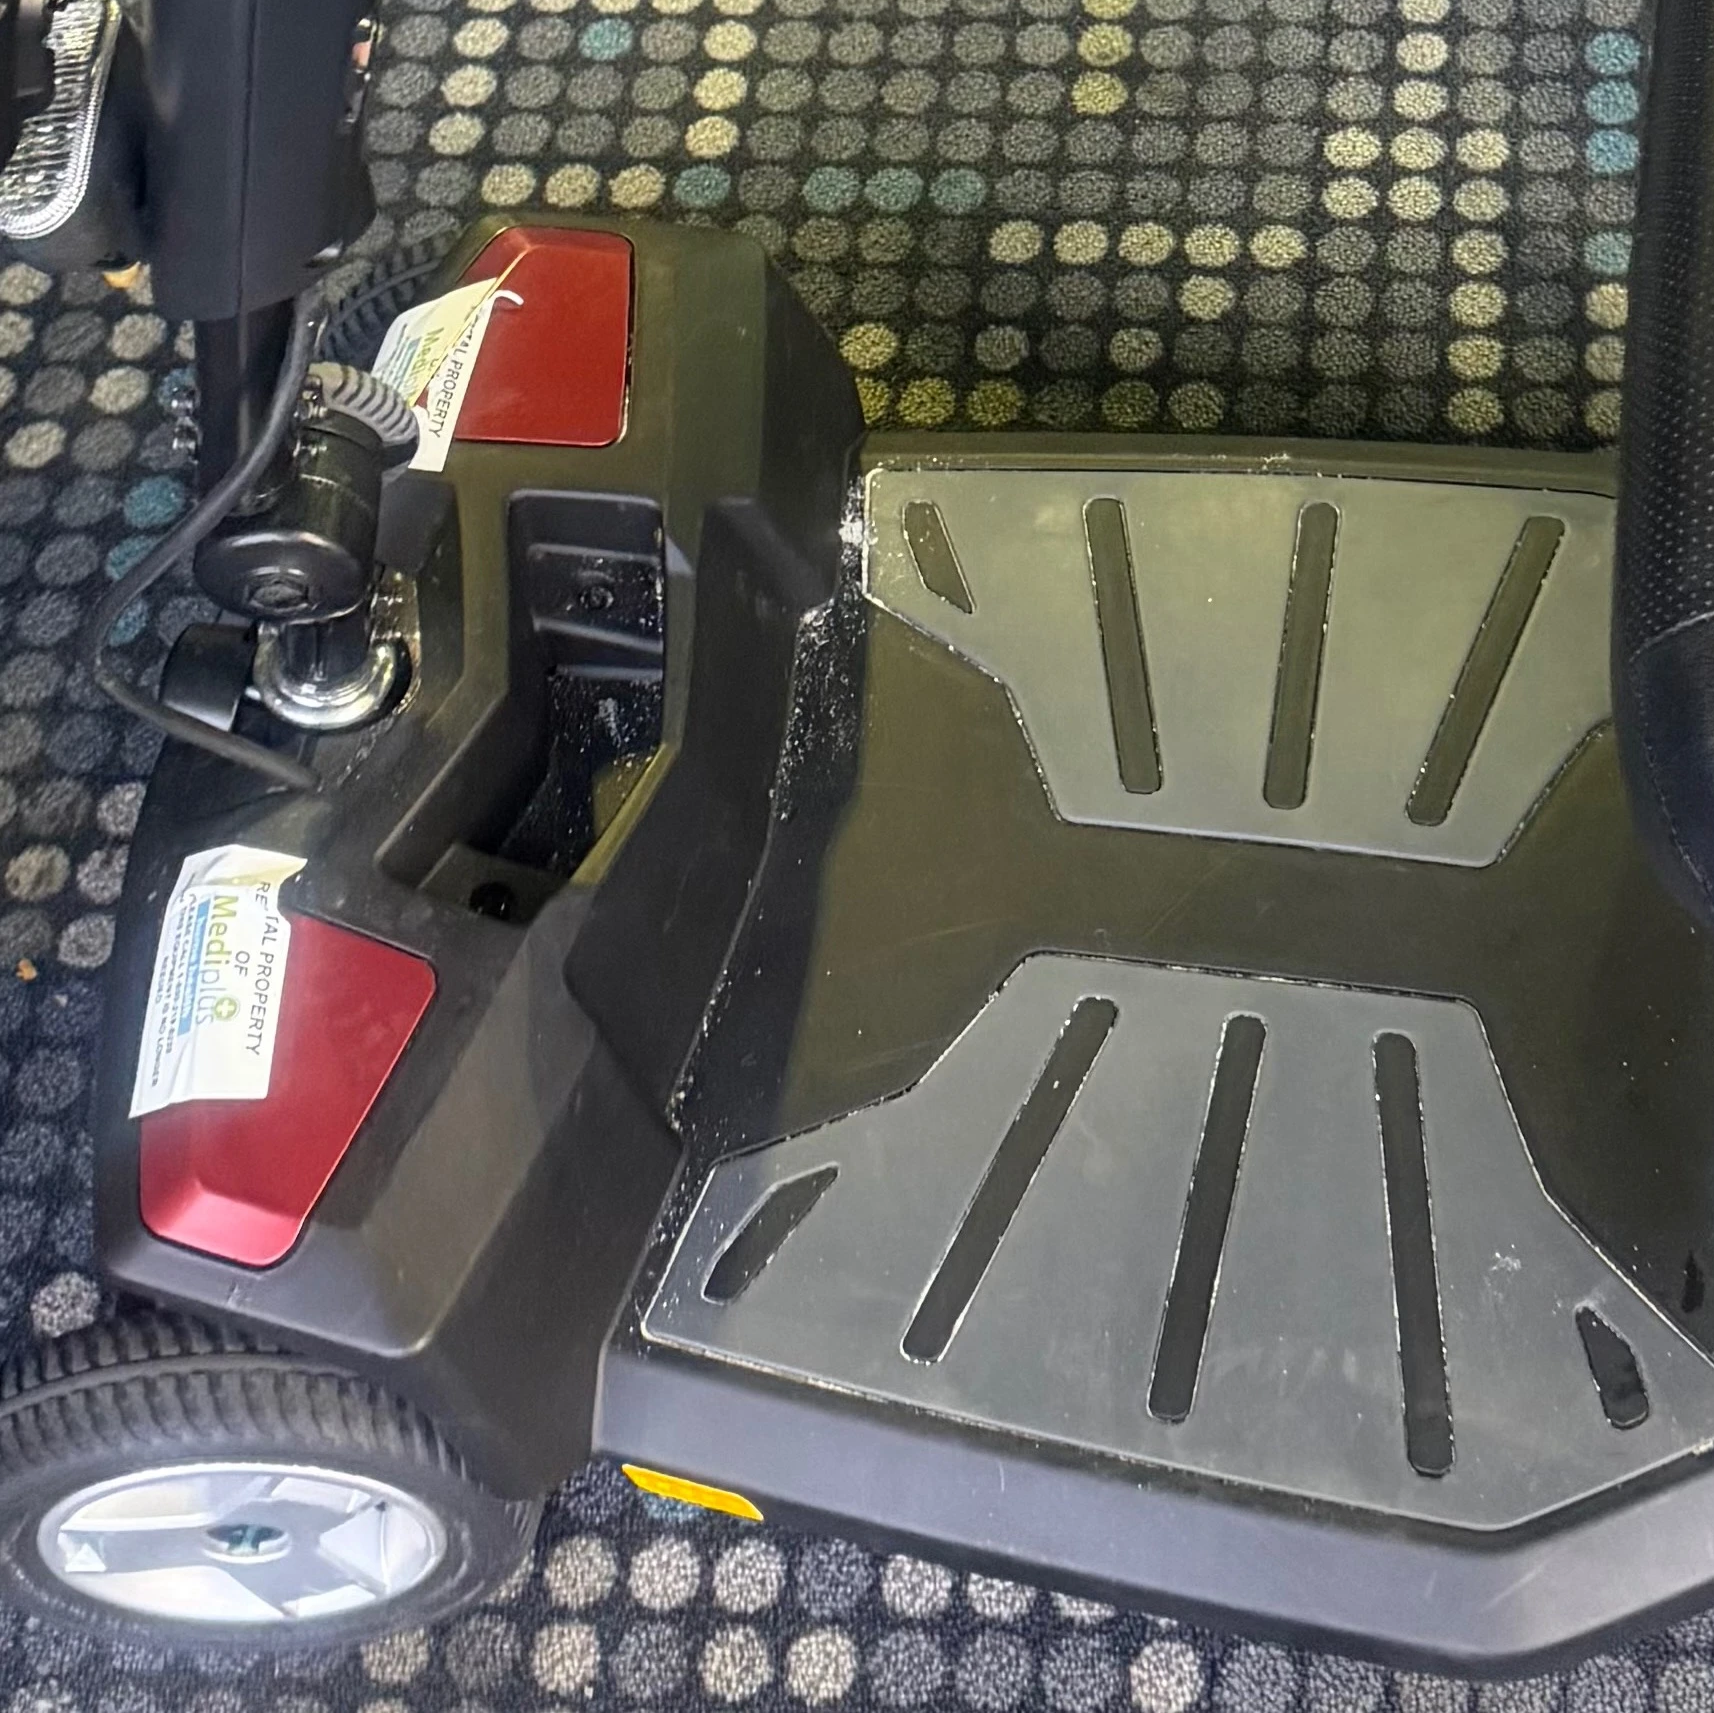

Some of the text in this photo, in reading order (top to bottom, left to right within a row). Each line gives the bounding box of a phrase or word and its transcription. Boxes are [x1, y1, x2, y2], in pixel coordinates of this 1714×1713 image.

[428, 359, 464, 438] PROPERTY
[195, 895, 239, 1024] Mediplus
[234, 951, 250, 976] OF
[246, 881, 279, 1055] RETAL PROPERTY
